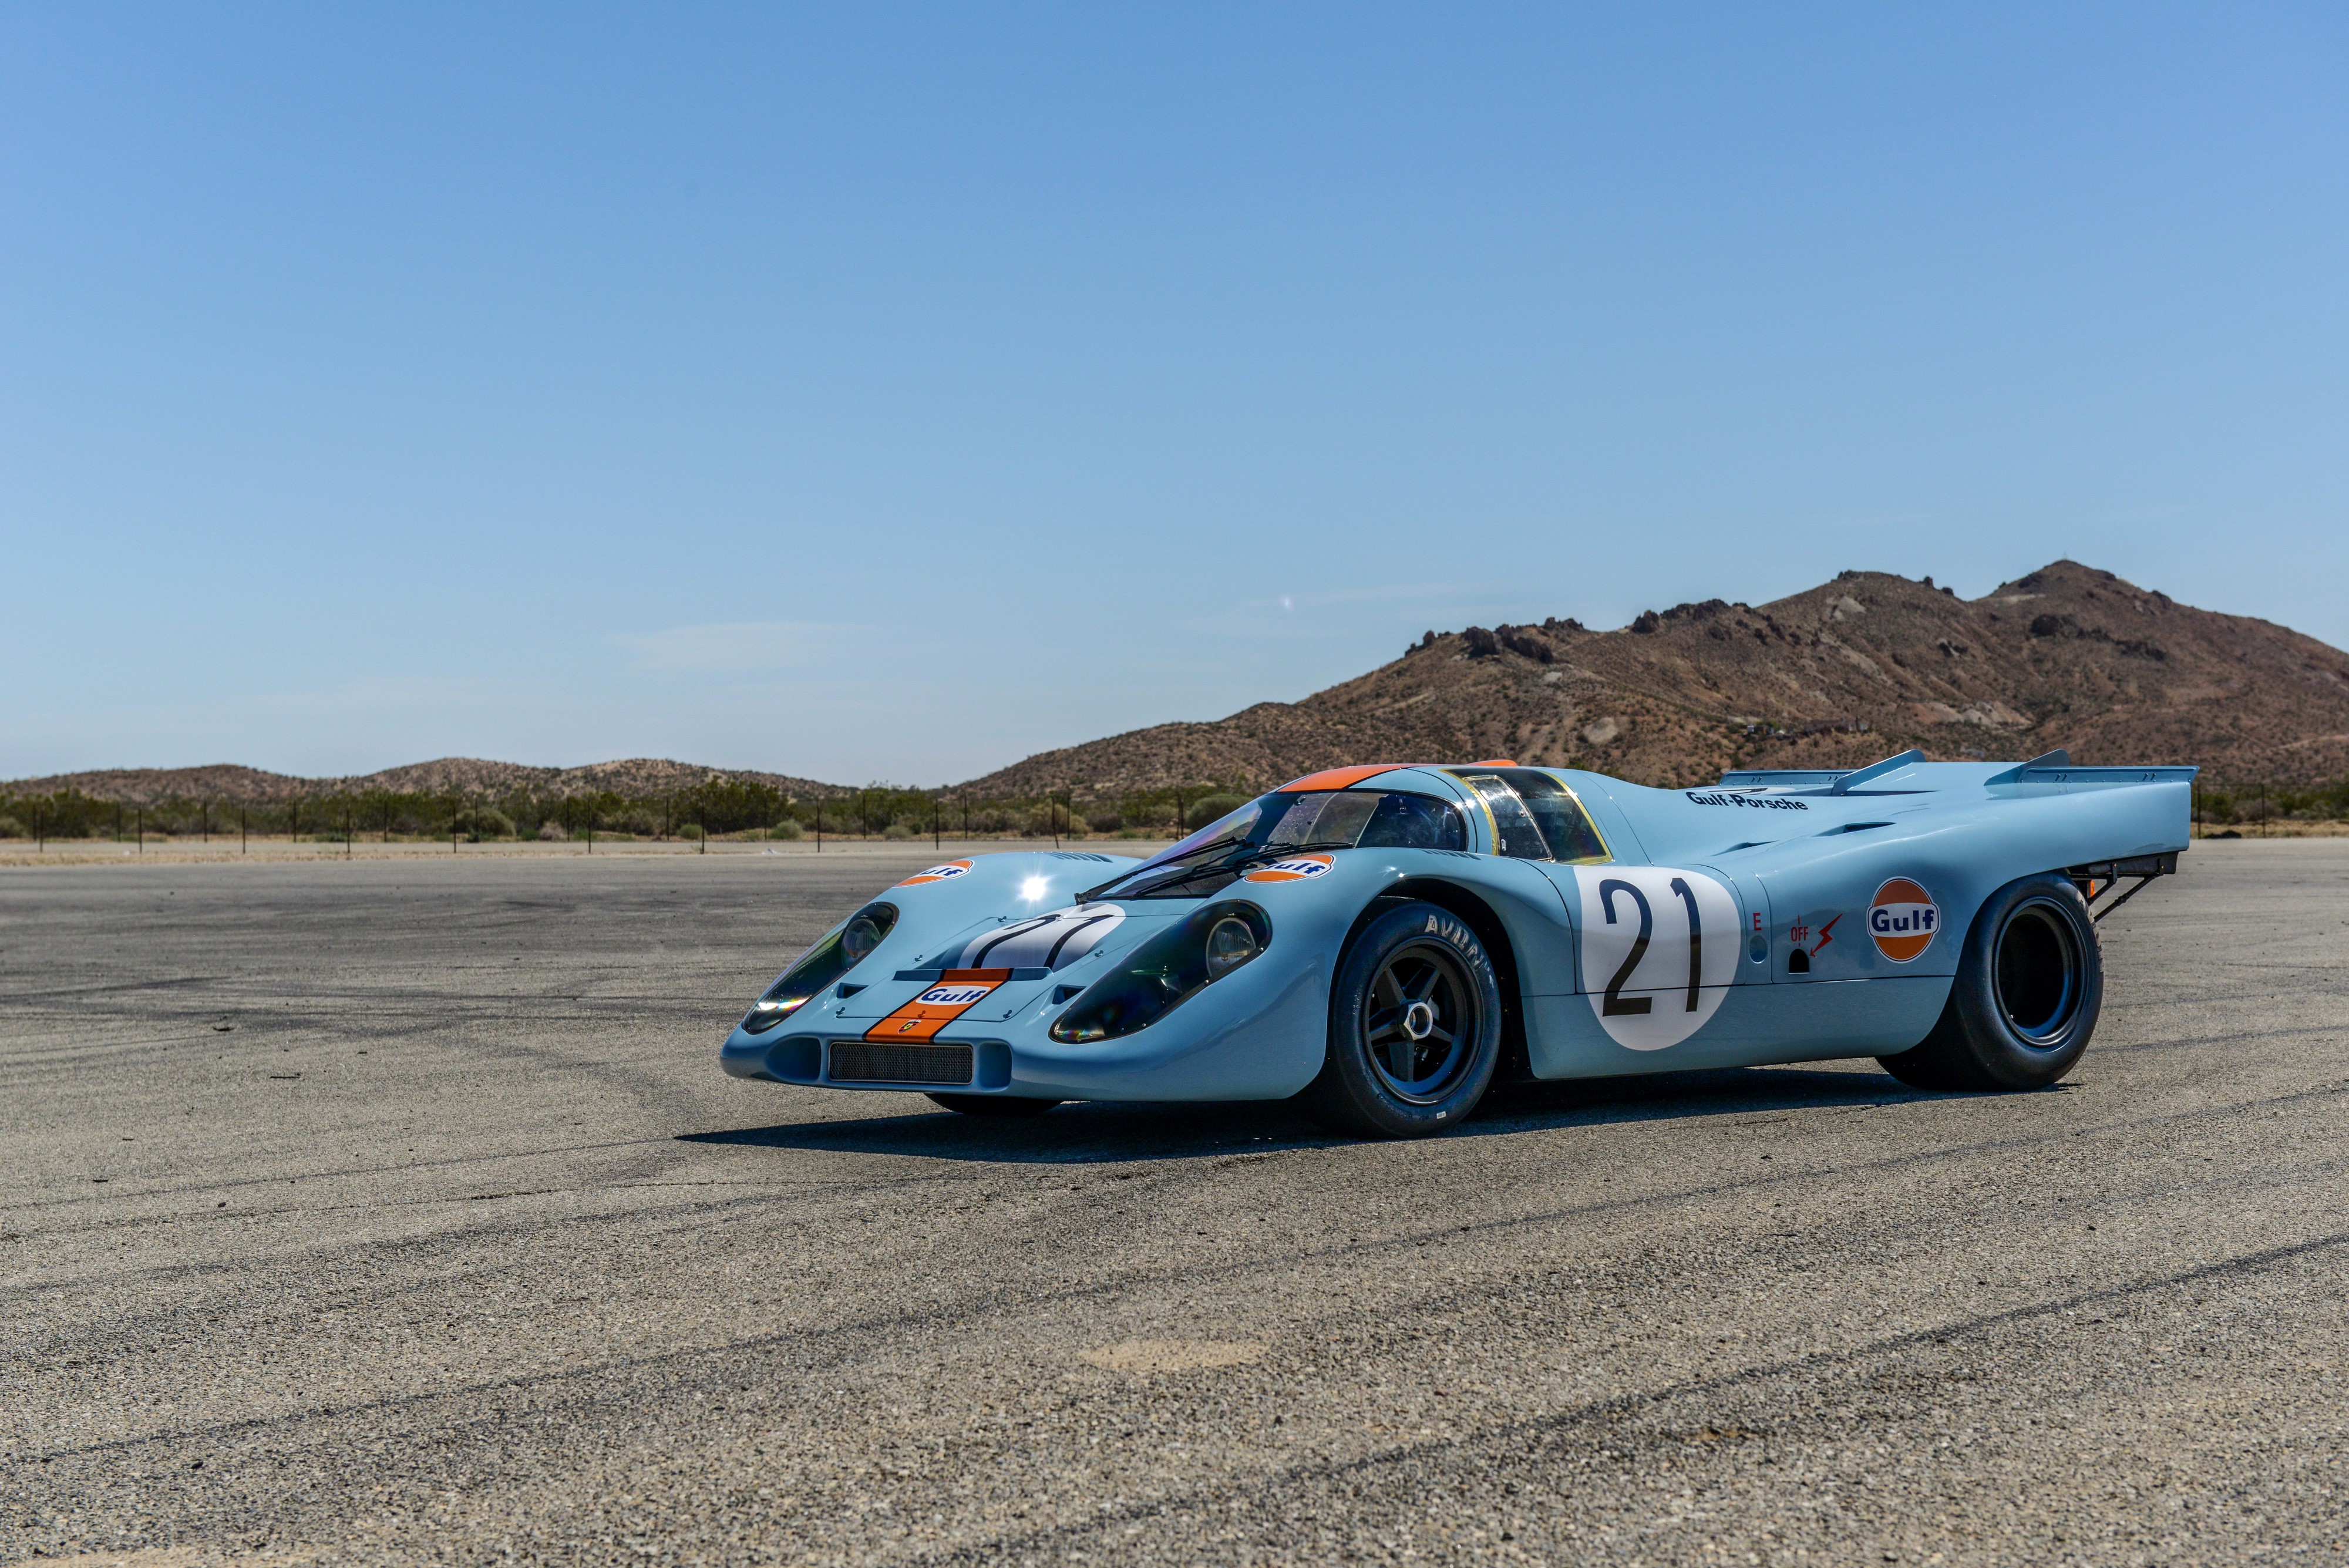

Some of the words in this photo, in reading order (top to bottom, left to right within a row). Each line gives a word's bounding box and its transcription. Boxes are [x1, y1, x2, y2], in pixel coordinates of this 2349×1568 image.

[1685, 791, 1809, 810] Gulf-Porsche
[1752, 912, 1762, 931] E
[1871, 909, 1934, 933] Gulf
[1791, 926, 1809, 942] OFF
[1598, 877, 1702, 1017] 21
[921, 988, 987, 1002] Gulf
